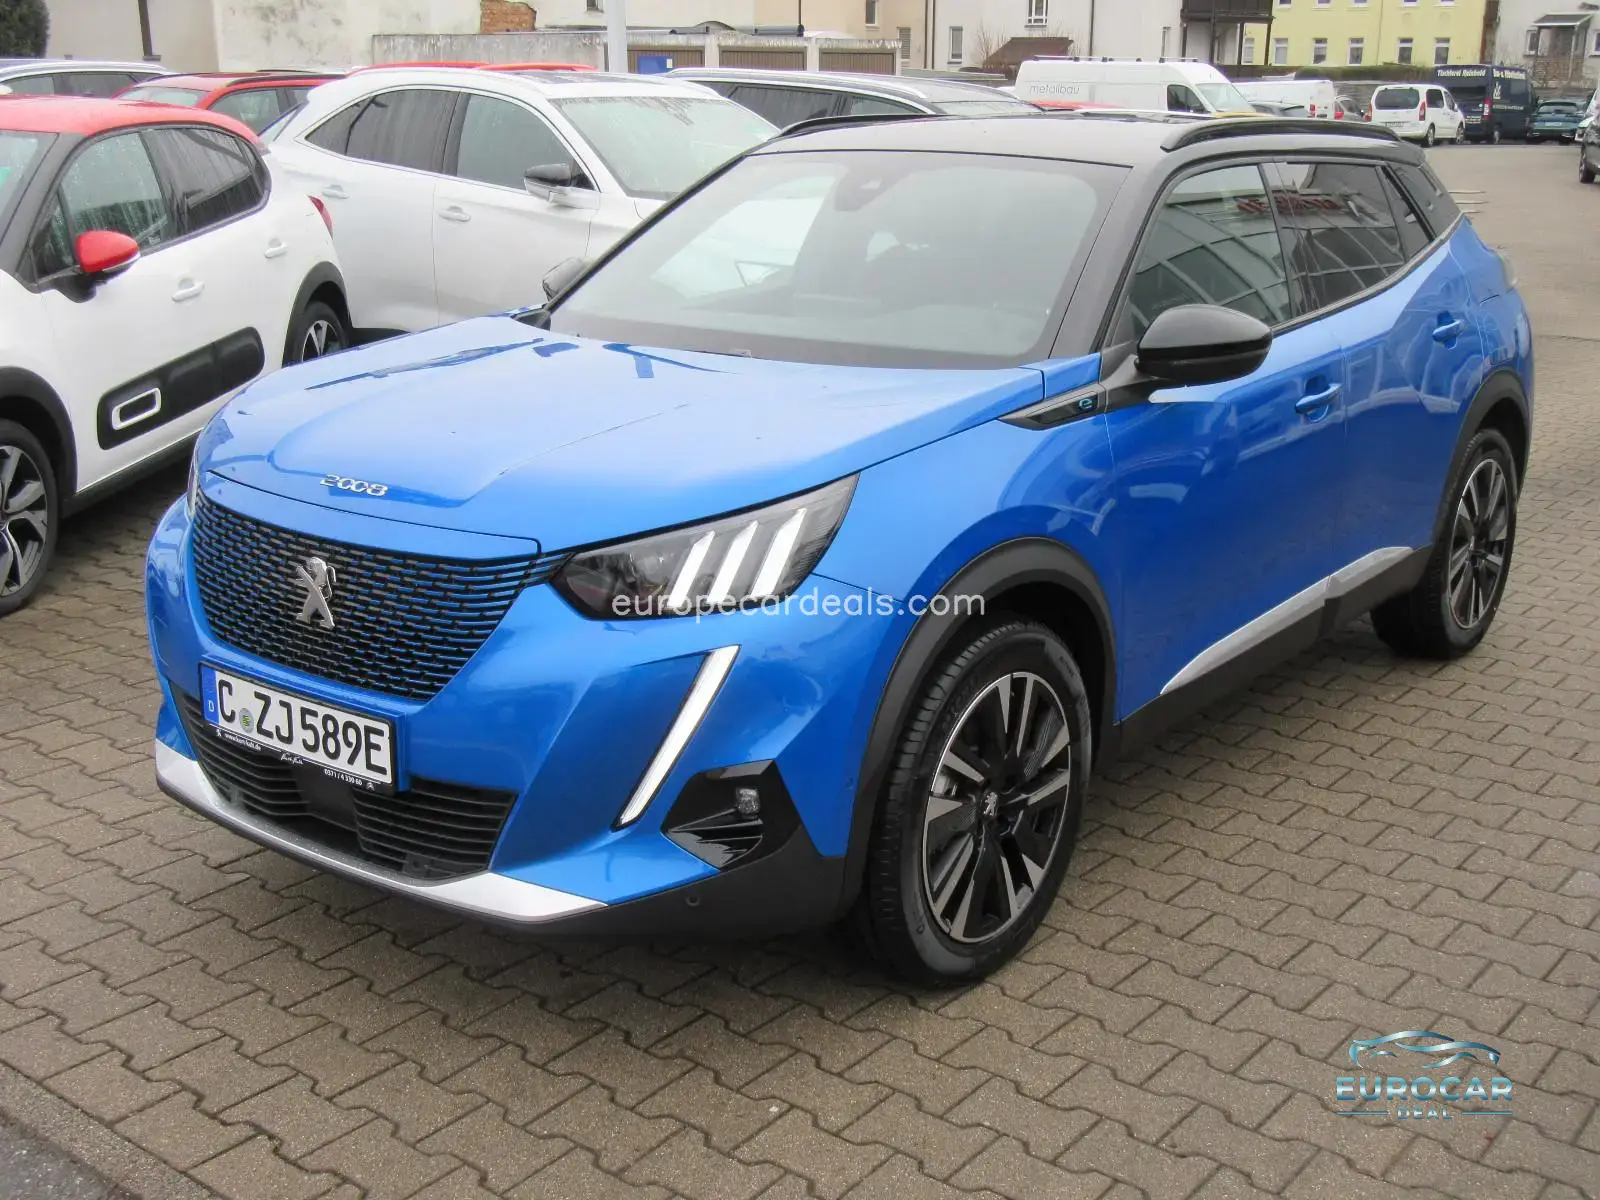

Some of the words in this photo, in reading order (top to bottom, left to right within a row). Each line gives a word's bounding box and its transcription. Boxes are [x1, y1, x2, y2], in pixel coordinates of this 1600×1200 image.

[1029, 83, 1080, 96] metallbau
[319, 474, 389, 497] 2008
[217, 678, 237, 724] C
